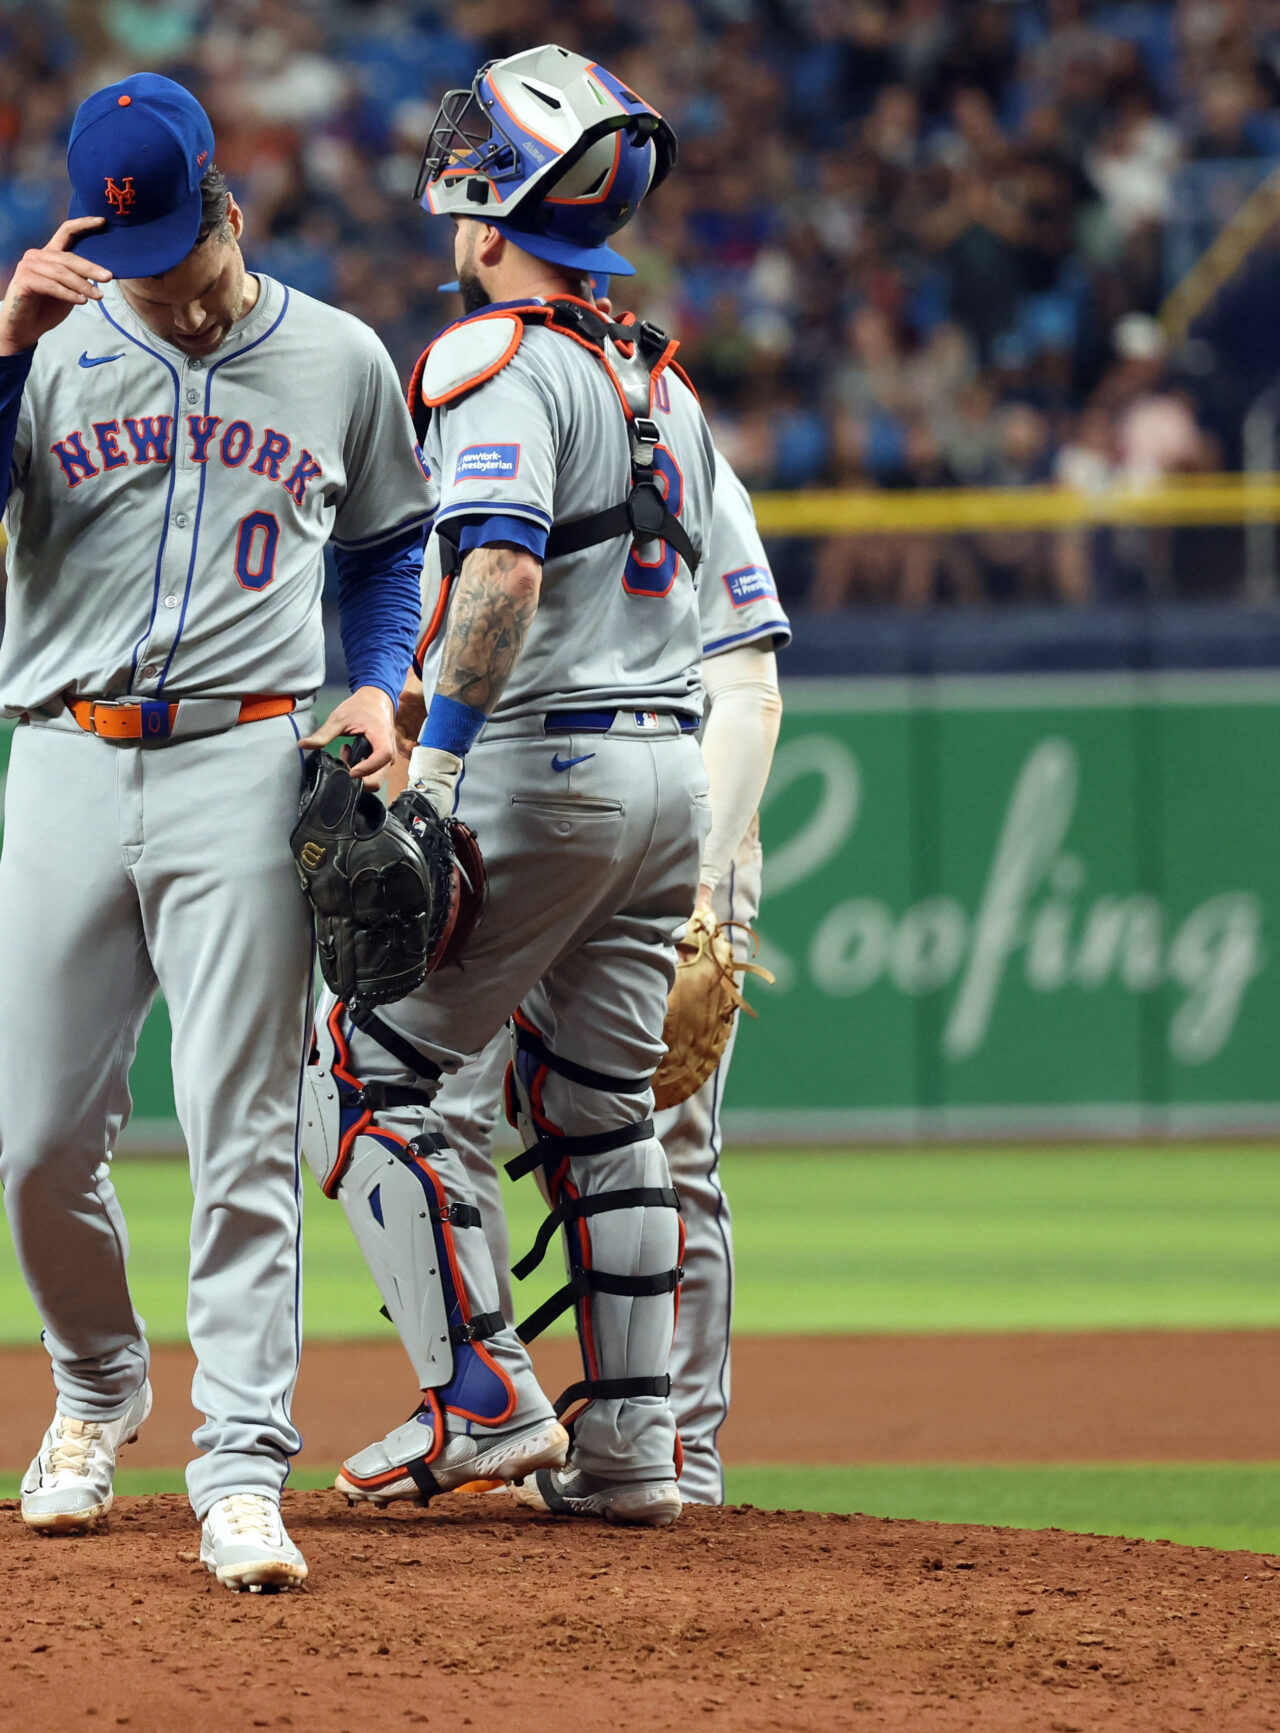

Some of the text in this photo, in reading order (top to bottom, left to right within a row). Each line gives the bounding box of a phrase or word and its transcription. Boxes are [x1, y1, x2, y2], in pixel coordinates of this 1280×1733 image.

[50, 415, 322, 506] NEW YORK
[234, 509, 280, 591] 0
